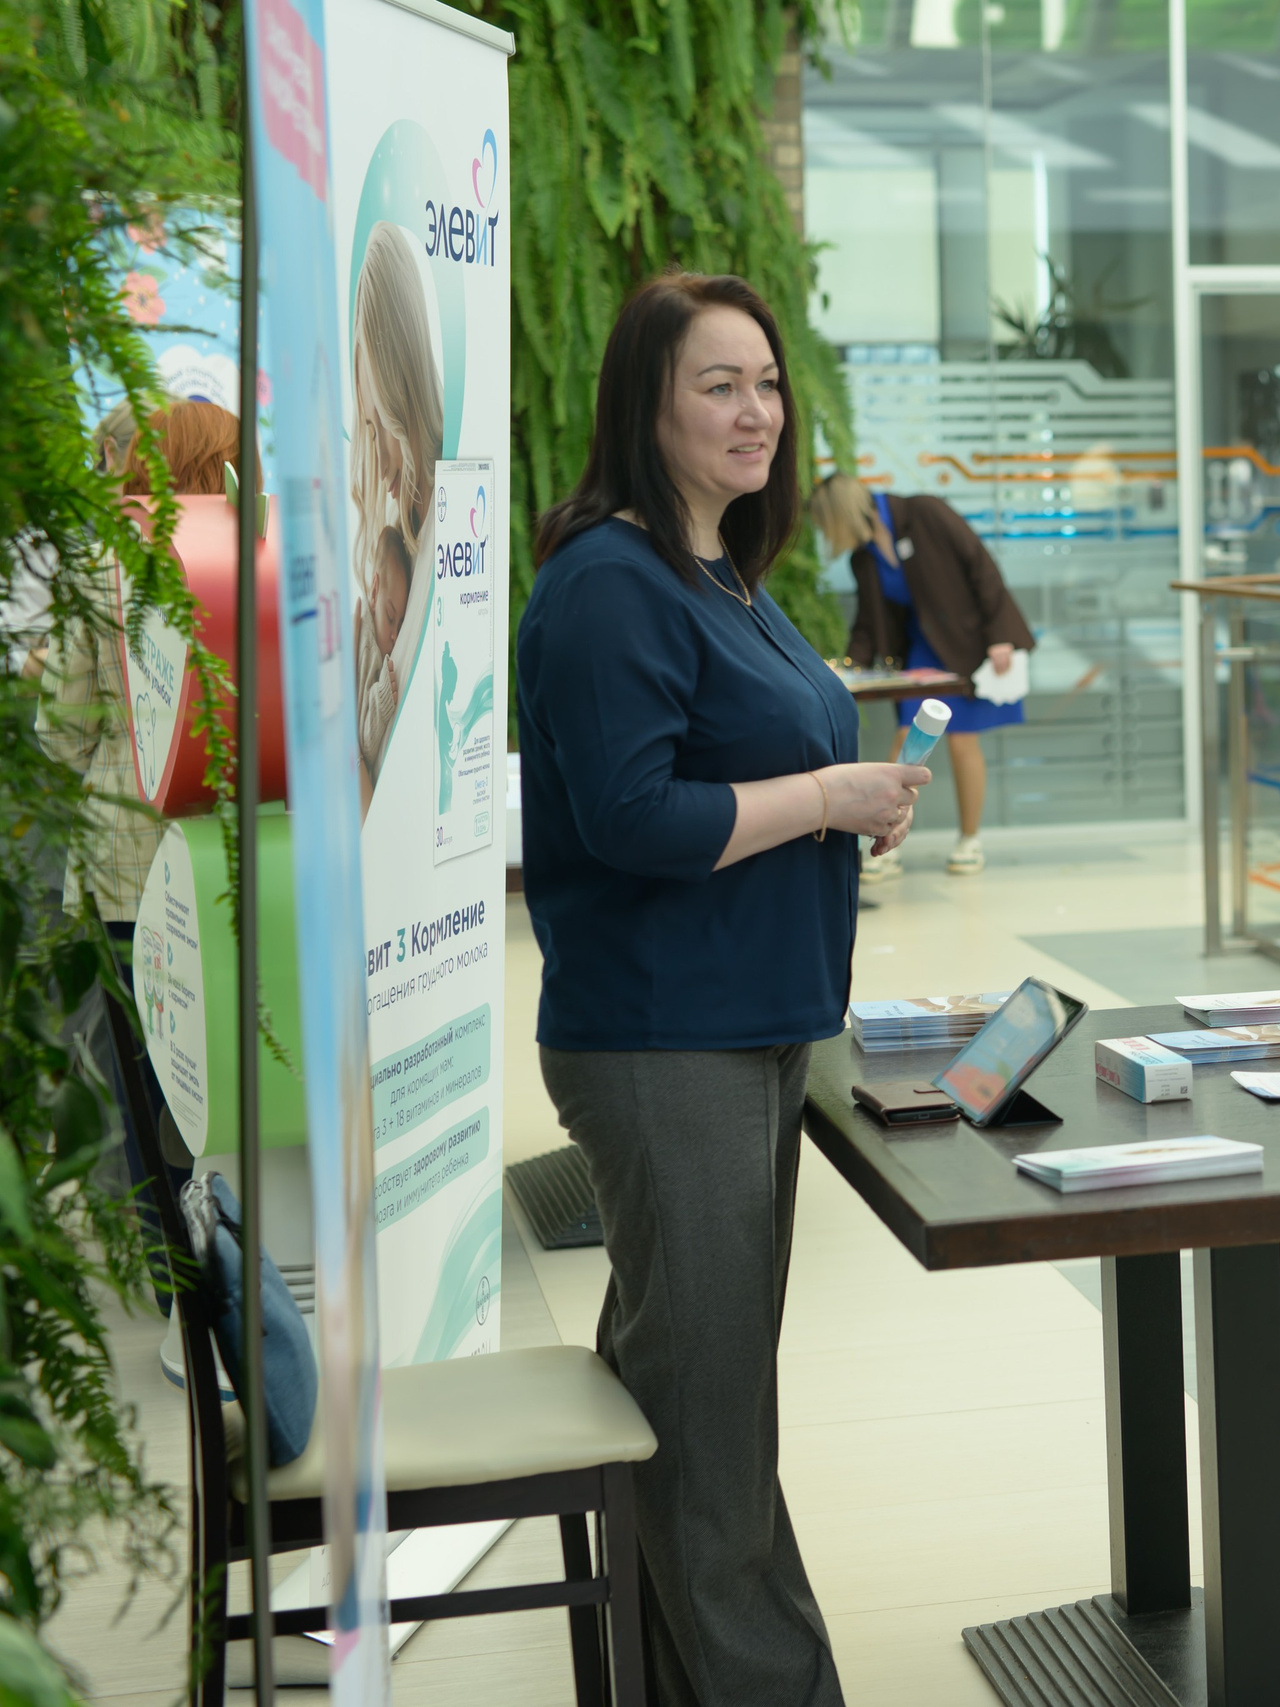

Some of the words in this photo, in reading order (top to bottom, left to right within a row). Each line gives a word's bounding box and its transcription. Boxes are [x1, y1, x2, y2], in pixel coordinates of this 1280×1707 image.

[437, 597, 442, 627] 3
[460, 590, 489, 608] кормление
[436, 826, 443, 848] 30
[365, 941, 391, 977] вит
[396, 927, 406, 962] 3
[412, 900, 485, 957] Кормление
[367, 978, 415, 1016] огащения
[417, 957, 454, 994] грудного
[456, 942, 488, 970] молока
[403, 1026, 454, 1075] разработанный
[454, 1014, 485, 1040] комплекс
[390, 1086, 406, 1107] для
[396, 1109, 405, 1128] 18
[445, 1065, 482, 1095] минералов
[413, 1140, 448, 1177] здоровому
[448, 1120, 481, 1153] развитию
